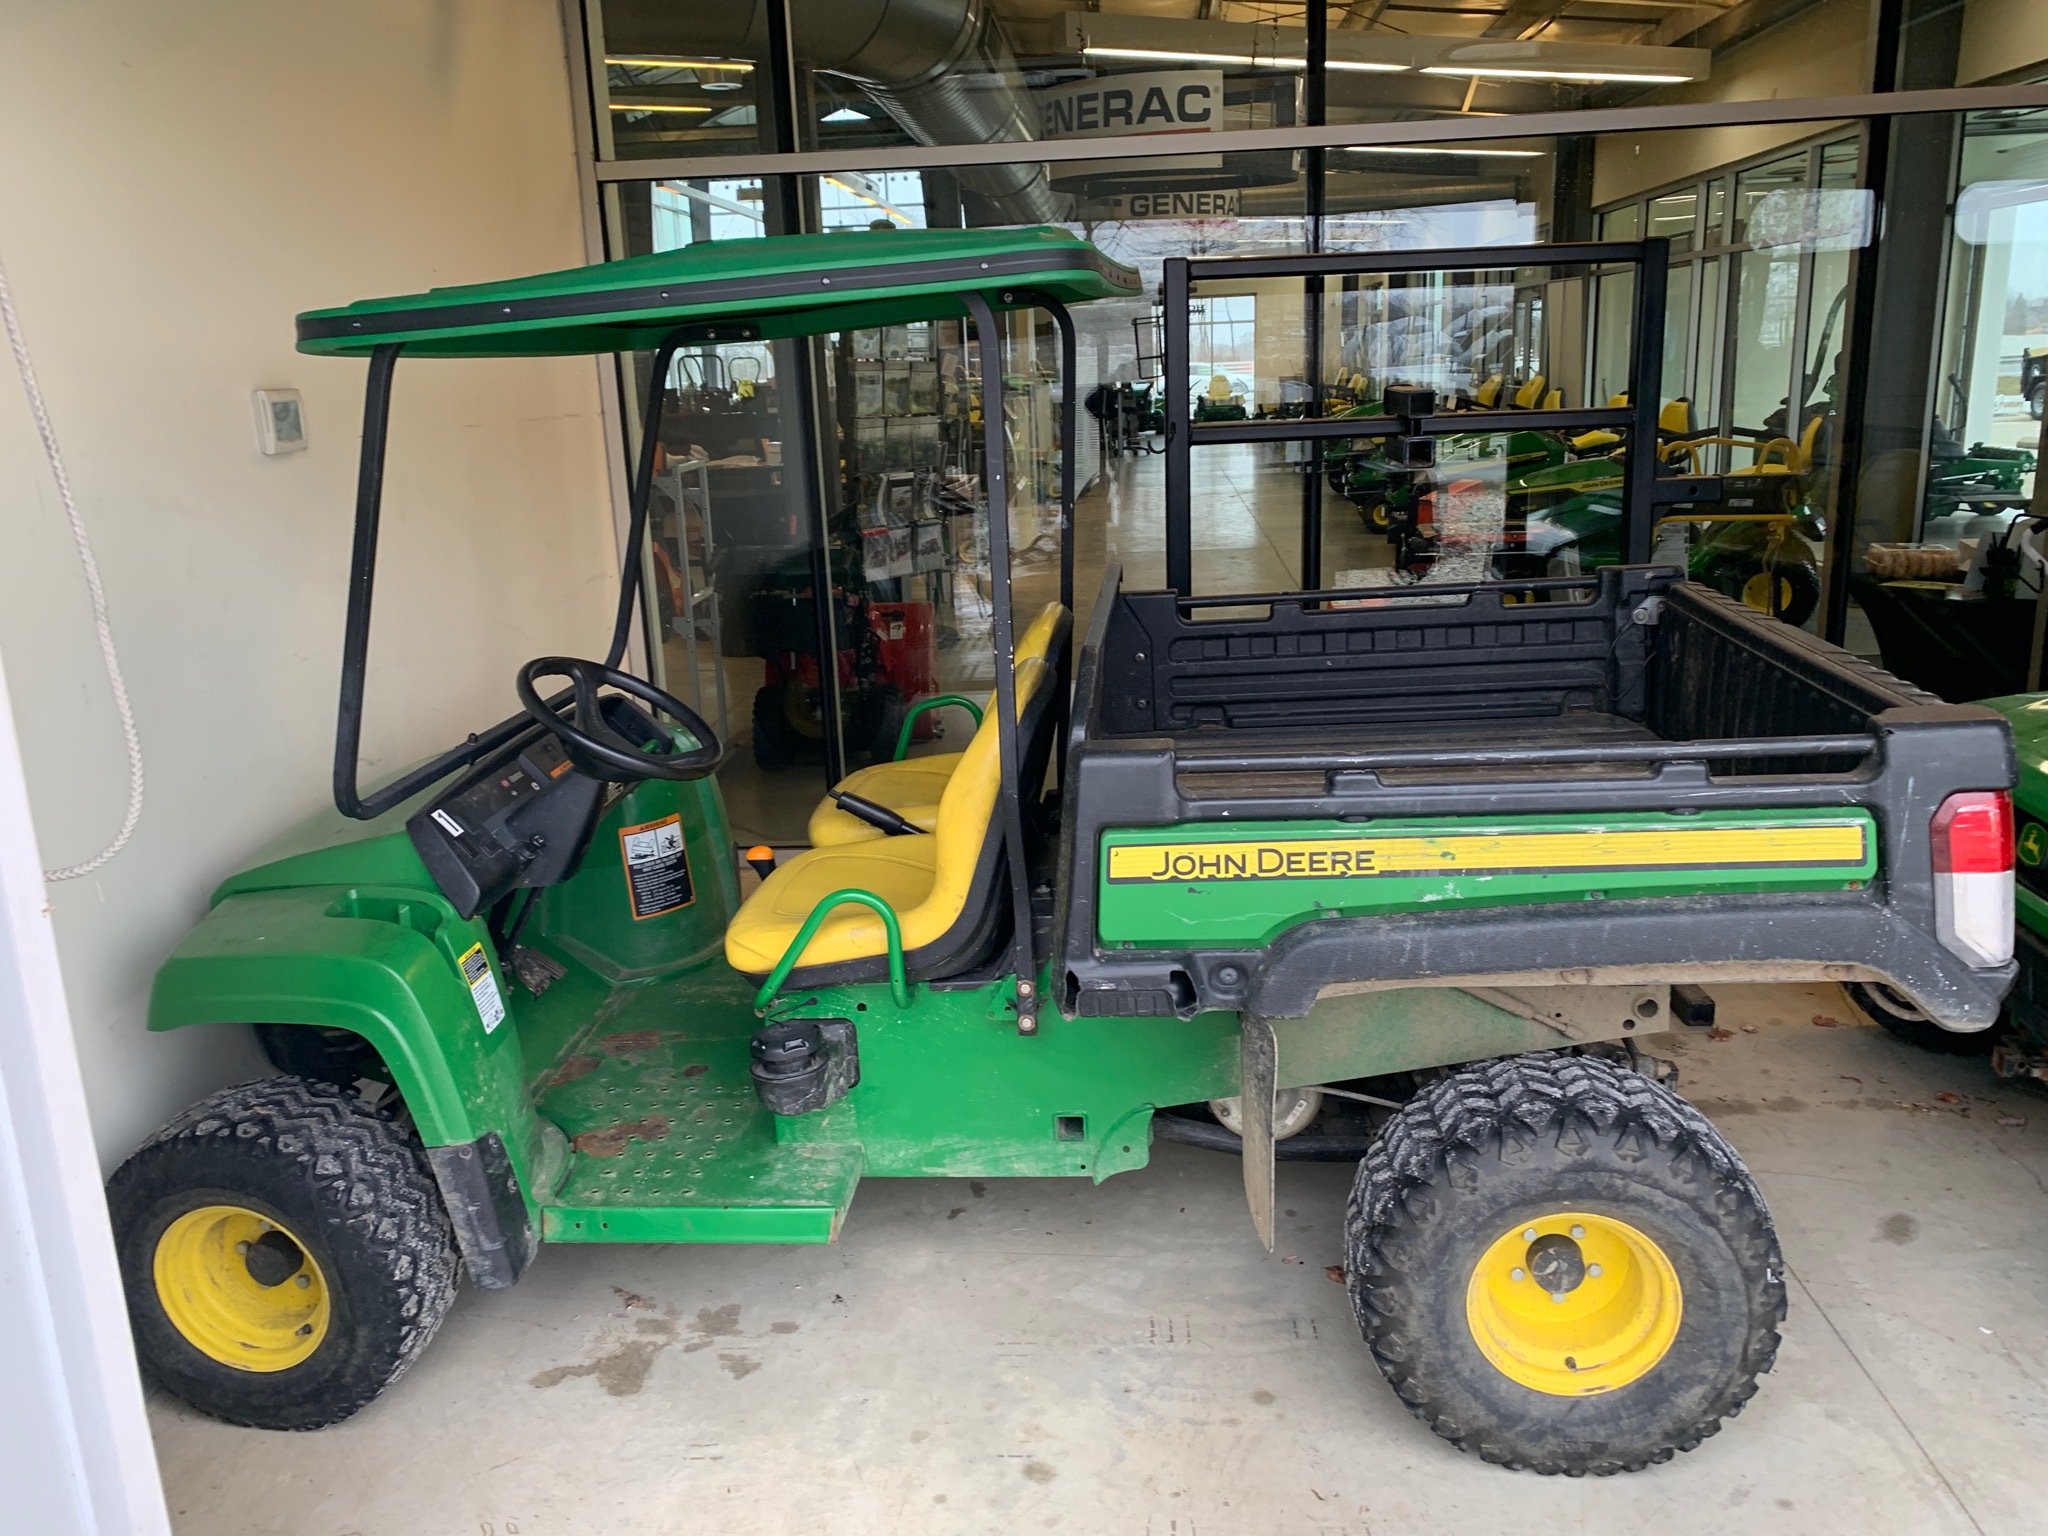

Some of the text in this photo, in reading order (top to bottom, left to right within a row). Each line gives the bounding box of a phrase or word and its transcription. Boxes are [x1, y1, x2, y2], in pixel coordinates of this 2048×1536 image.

[1041, 85, 1211, 136] ENERAC
[1152, 848, 1375, 876] JOHN DEERE
